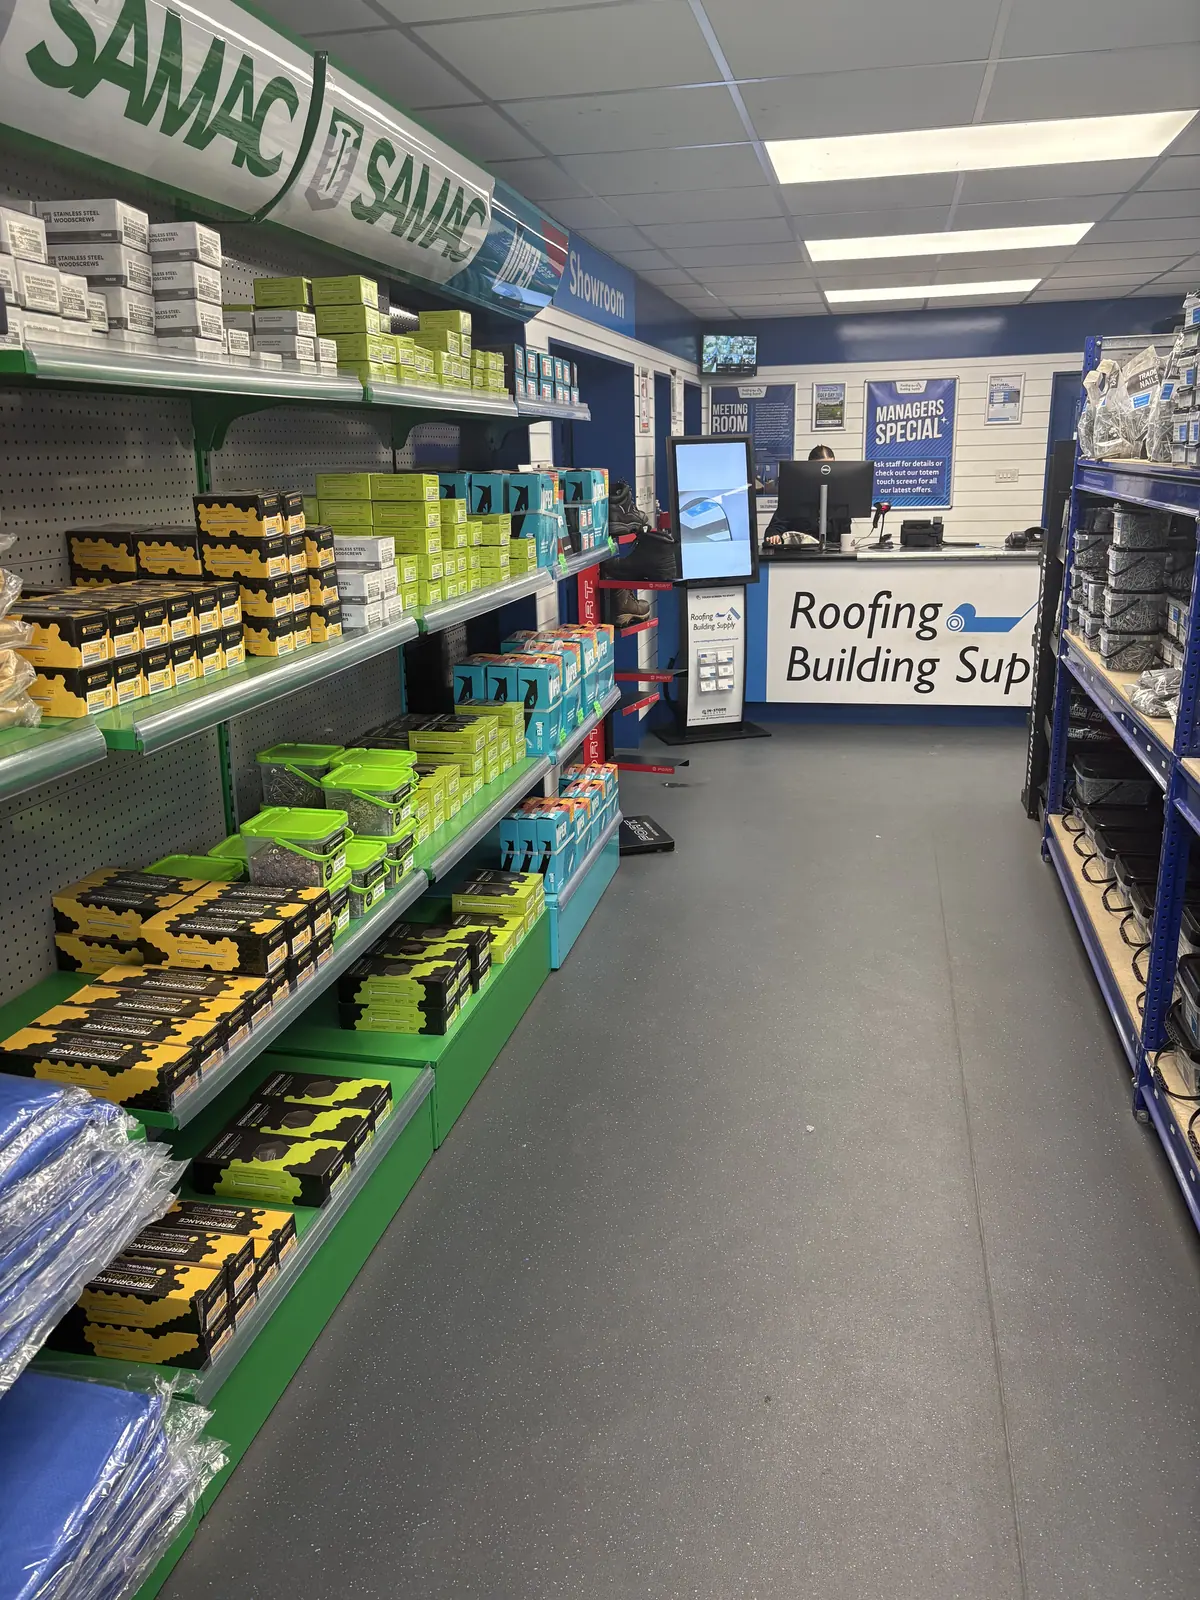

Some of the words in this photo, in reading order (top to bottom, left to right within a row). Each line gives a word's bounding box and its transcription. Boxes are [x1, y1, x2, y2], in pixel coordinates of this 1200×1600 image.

[25, 0, 299, 178] SAMAC
[350, 137, 487, 263] SAMAC
[569, 250, 625, 319] Showroom
[1140, 376, 1159, 389] NAILS
[712, 403, 748, 416] MEETING
[876, 399, 945, 423] MANAGERS
[712, 415, 748, 433] ROOM
[876, 417, 943, 445] SPECIAL
[1039, 554, 1047, 623] HEAVY
[690, 612, 713, 621] Roofing
[790, 590, 943, 640] Roofing
[693, 623, 715, 631] Building
[716, 621, 736, 630] Supply
[786, 645, 940, 693] Building
[955, 646, 1031, 694] Sup
[180, 923, 238, 932] PERFORMANCE
[143, 980, 207, 990] PERFORMANCE
[115, 1002, 182, 1012] PERFORMANCE
[82, 1023, 151, 1035] PERFORMANCE
[50, 1048, 121, 1060] PERFORMANCE
[179, 1217, 237, 1229] PERFORMANCE
[192, 1214, 241, 1224] STRUCTURAL
[130, 1243, 189, 1254] PERFORMANC
[126, 1263, 158, 1271] STRUCTURAL
[106, 1272, 160, 1284] STRUCTURAL
